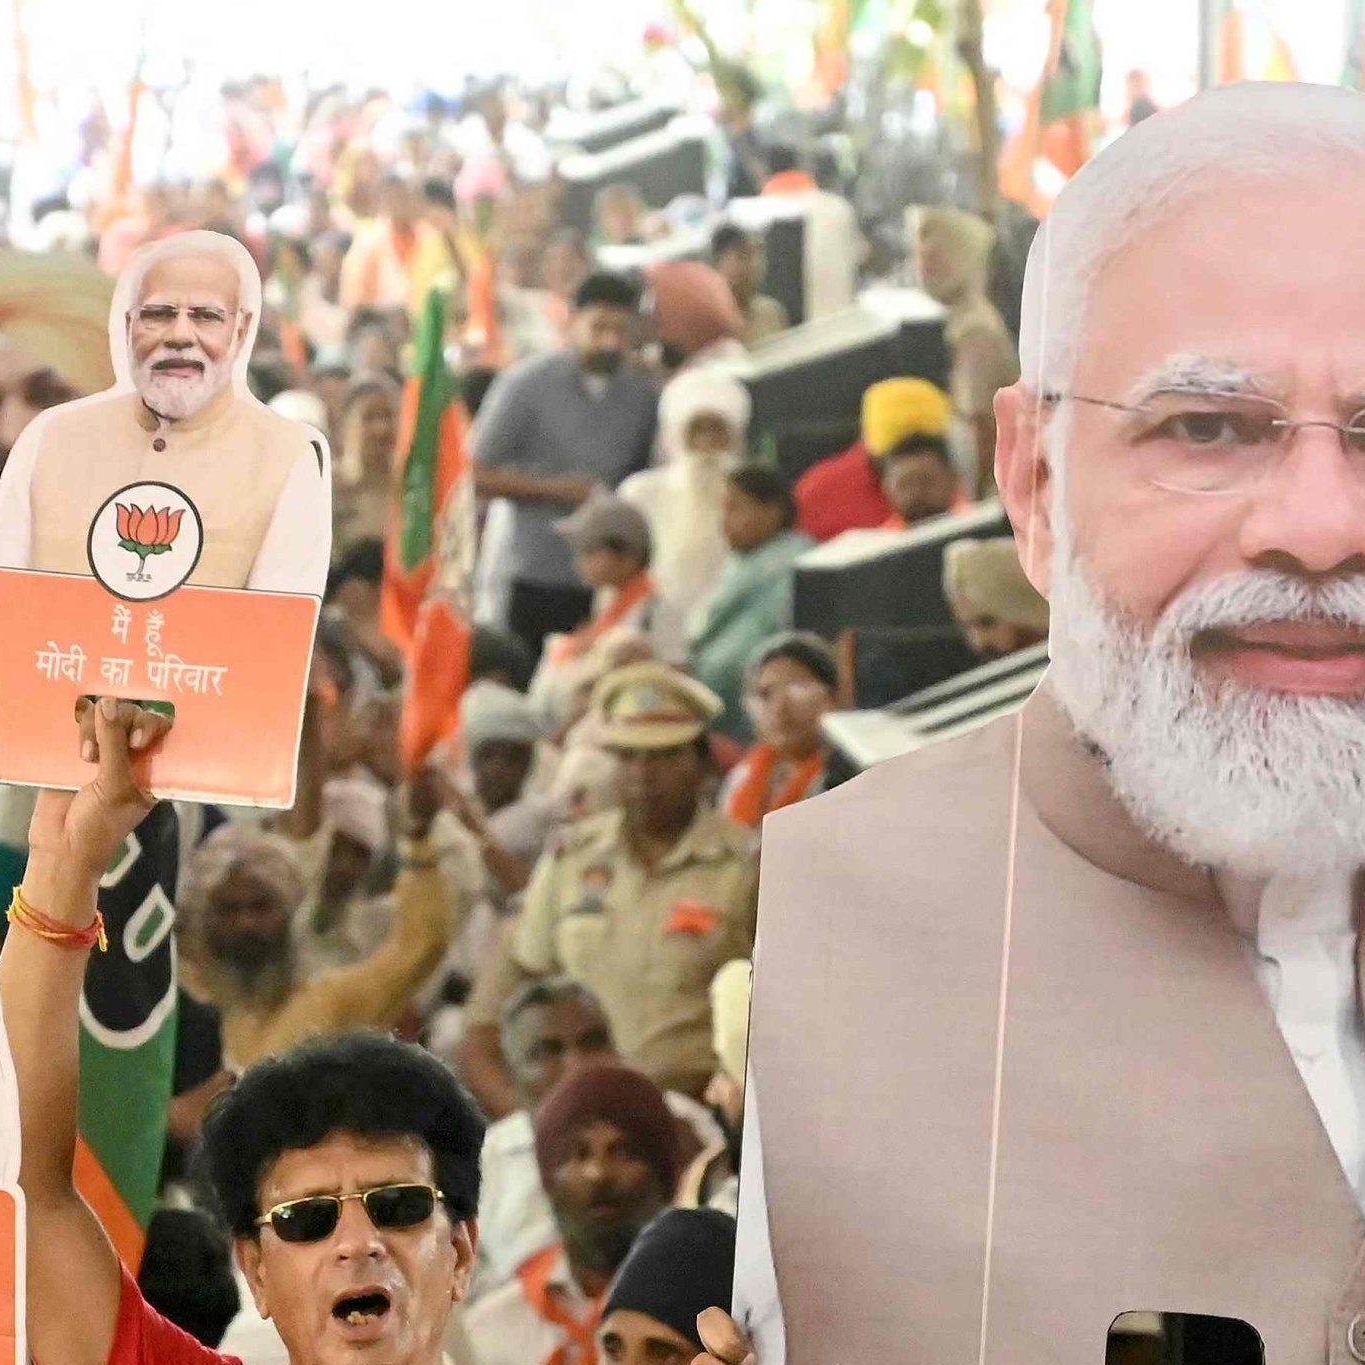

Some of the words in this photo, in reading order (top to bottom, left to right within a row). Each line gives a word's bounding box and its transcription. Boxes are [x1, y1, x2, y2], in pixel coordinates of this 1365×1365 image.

[111, 604, 132, 644] मैं
[144, 608, 164, 658] हूँ
[35, 641, 87, 682] मोदी
[99, 656, 134, 687] का
[146, 653, 228, 695] परिवार
